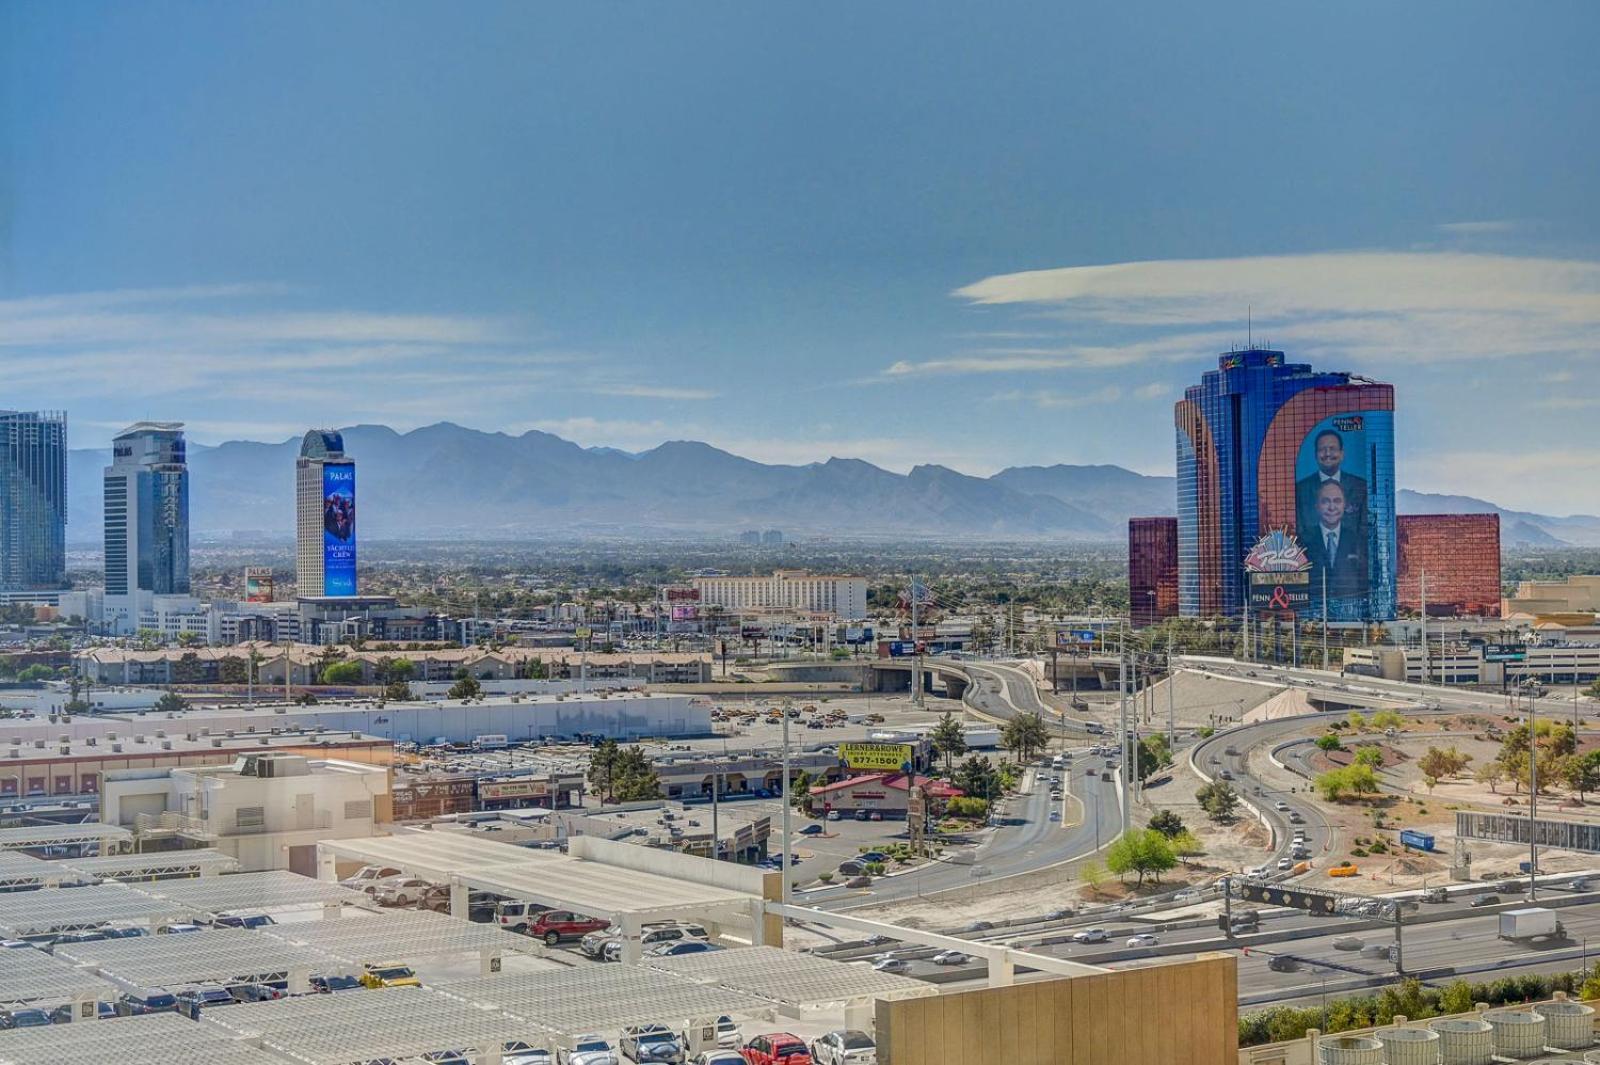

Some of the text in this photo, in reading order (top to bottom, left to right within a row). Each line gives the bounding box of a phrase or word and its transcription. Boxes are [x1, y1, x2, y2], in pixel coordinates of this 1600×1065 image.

[330, 472, 353, 480] PALMS
[1252, 593, 1270, 602] PENN
[1288, 593, 1309, 601] TELLER
[853, 756, 898, 765] 877-1500
